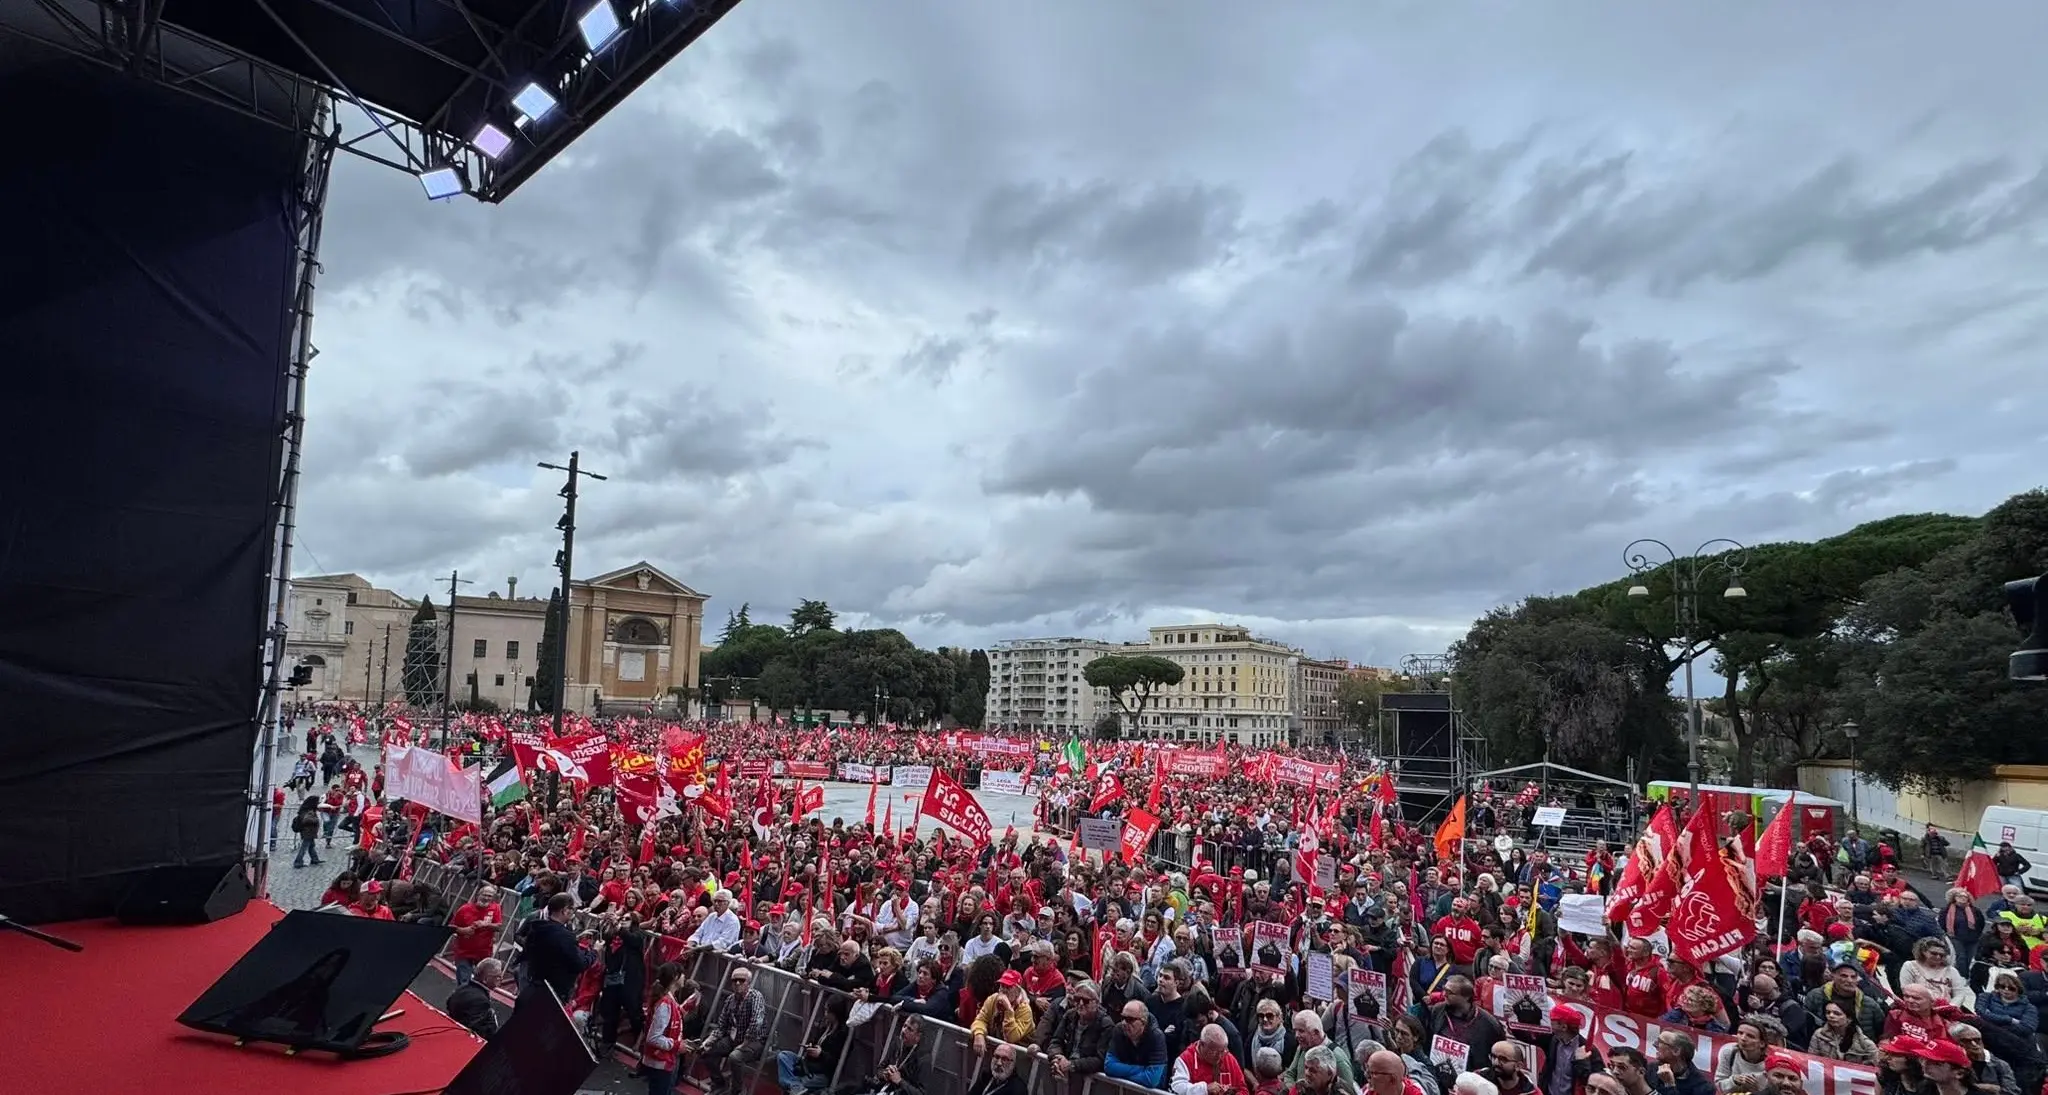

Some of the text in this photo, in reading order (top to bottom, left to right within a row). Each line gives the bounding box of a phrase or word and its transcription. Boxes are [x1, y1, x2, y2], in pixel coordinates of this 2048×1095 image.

[1214, 929, 1239, 940] FREE
[1258, 921, 1289, 936] FREE
[1351, 968, 1384, 982] FREE
[1506, 974, 1542, 988] FREE
[1435, 1036, 1467, 1054] FREE
